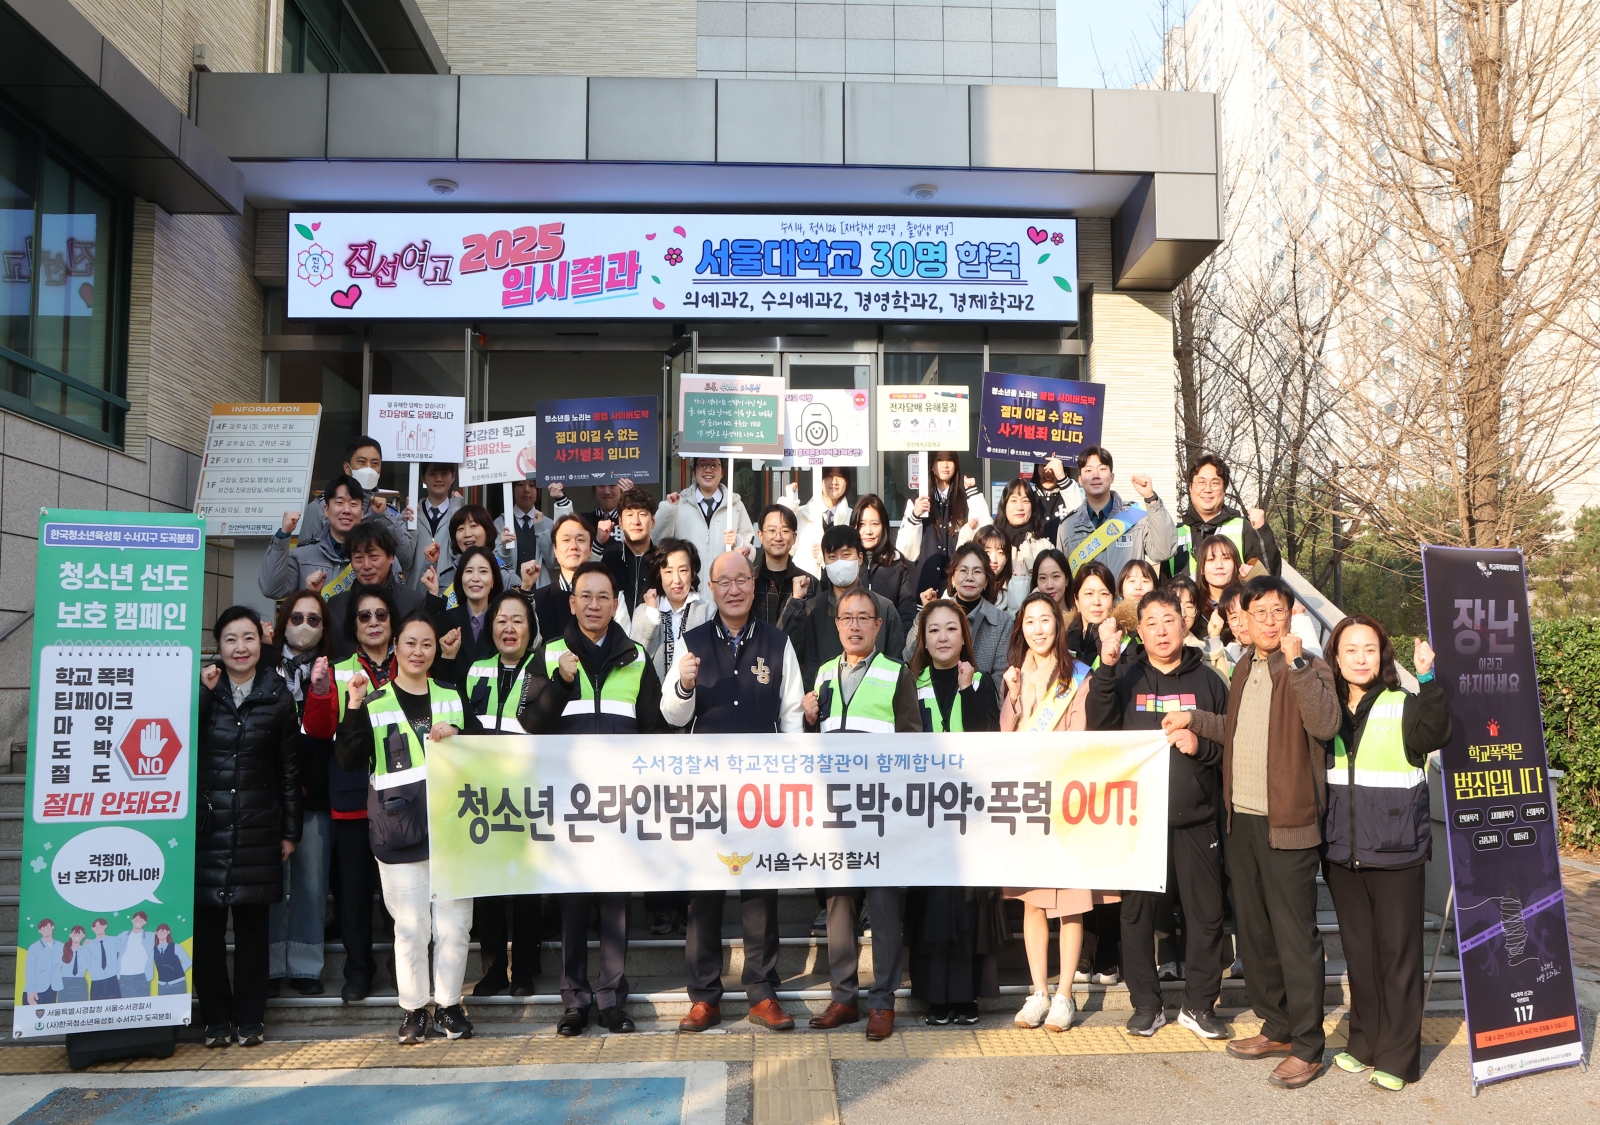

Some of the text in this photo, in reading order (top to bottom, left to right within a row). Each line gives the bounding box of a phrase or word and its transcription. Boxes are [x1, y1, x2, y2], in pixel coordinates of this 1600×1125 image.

[906, 220, 932, 239] 졸업생
[459, 222, 565, 274] 2025
[346, 240, 454, 288] 진선여고
[695, 238, 1021, 279] 서울대학교 30명 합격
[501, 249, 643, 309] 입시결과
[683, 289, 1035, 314] 의예과2, 수의예과2, 경영학과2, 경제학과2
[991, 387, 1017, 397] 청소년을
[1018, 390, 1038, 399] 노리는
[1057, 393, 1096, 405] 사이버도박
[379, 409, 454, 420] 전자담배도 담배입니다
[544, 414, 571, 423] 청소년을
[571, 413, 592, 422] 노리는
[610, 410, 650, 420] 사이버도박
[889, 401, 957, 413] 전자담배 유해물질
[1000, 405, 1084, 425] 절대 이길 수 없는
[465, 424, 526, 443] 건강한 학교
[555, 428, 639, 444] 절대 이길 수 없는
[997, 422, 1083, 444] 사기범죄 입니다
[465, 441, 512, 457] 담배없는
[554, 446, 641, 464] 사기범죄 입니다
[466, 458, 490, 471] 학교
[206, 481, 217, 489] 1F
[471, 471, 508, 482] 진선여자고등학교
[50, 528, 194, 544] 한국청소년육성회 수서지구 도곡분회
[59, 561, 189, 592] 청소년 선도
[56, 601, 187, 631] 보호 캠페인
[1452, 598, 1519, 655] 장난
[1478, 657, 1503, 671] 이라고
[55, 667, 134, 686] 학교 폭력
[1459, 673, 1520, 695] 하지마세요
[54, 691, 133, 711] 딥페이크
[1468, 742, 1523, 762] 학교폭력은
[137, 757, 164, 775] NO
[631, 753, 965, 775] 수서경찰서 학교전담경찰관이 함께합니다
[1453, 766, 1544, 800] 범죄입니다
[42, 790, 181, 817] 절대 안돼요!
[457, 783, 556, 844] 청소년
[563, 783, 727, 843] 온라인범죄
[737, 783, 814, 830] OUT!
[1061, 780, 1139, 827] OUT!
[89, 853, 132, 867] 걱정마,
[755, 851, 881, 872] 서울수서경찰서
[57, 867, 160, 885] 넌 혼자가 아니야!
[46, 1002, 152, 1017] 서울특별시경찰청 서울수서경찰서
[1514, 1004, 1534, 1023] 117
[46, 1012, 172, 1029] (사)한국청소년육성회 수서지구 도곡분회
